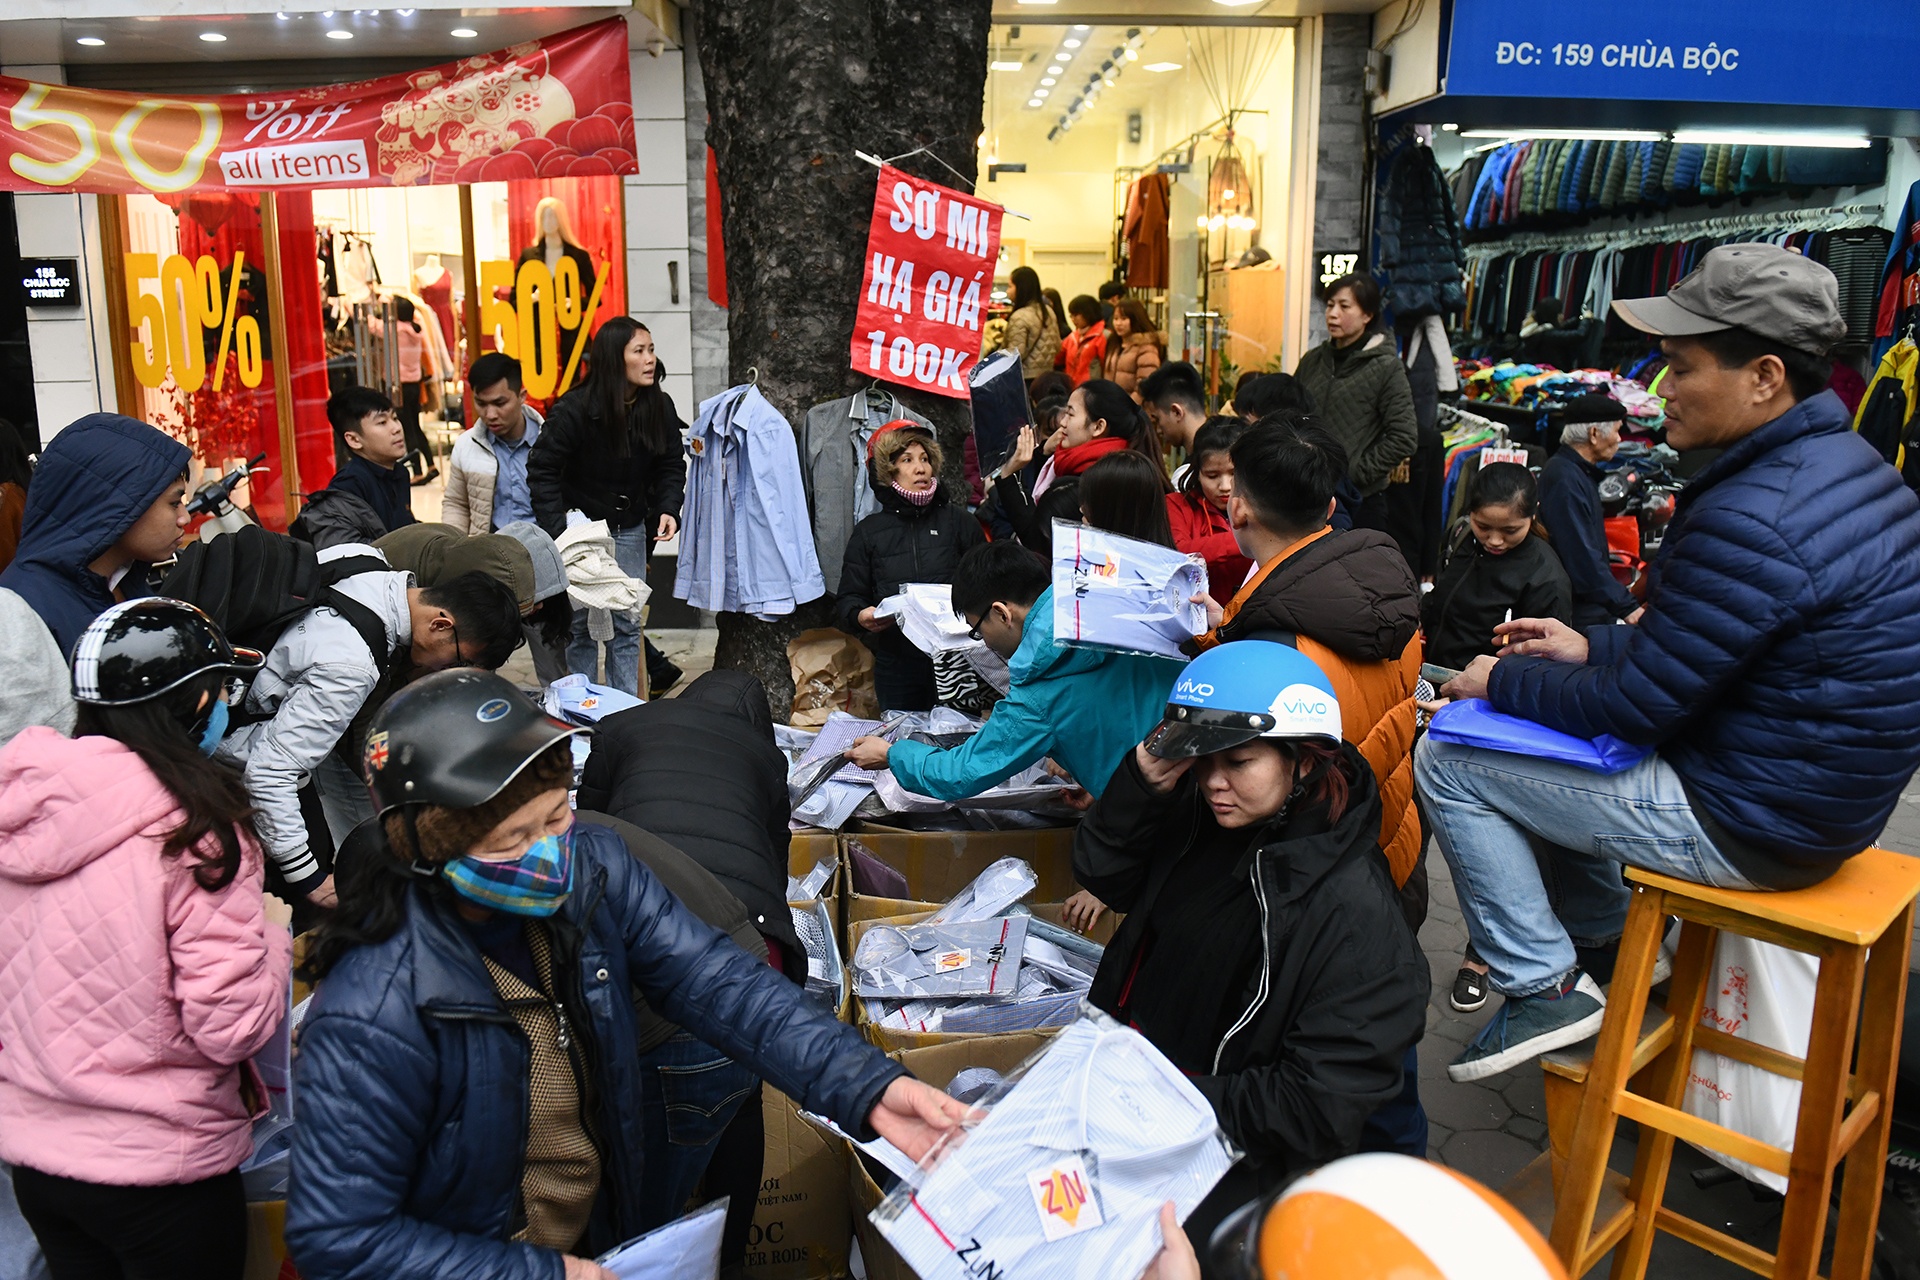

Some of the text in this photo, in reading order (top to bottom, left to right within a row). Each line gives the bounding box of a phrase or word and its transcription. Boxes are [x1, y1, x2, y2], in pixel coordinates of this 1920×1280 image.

[1496, 39, 1739, 76] ĐC: 159 CHÙA BỘC
[9, 82, 223, 193] 50
[226, 151, 361, 180] all items
[890, 181, 990, 259] SƠ MI
[1321, 254, 1359, 275] 157
[23, 278, 49, 288] CHUA
[30, 289, 65, 298] STREET
[867, 252, 985, 332] HẠ GIÁ
[125, 251, 263, 392] 50%
[867, 329, 970, 391] 100K
[1177, 678, 1214, 697] vivo
[1283, 698, 1327, 715] vivo
[782, 1192, 802, 1204] NAM
[1039, 1169, 1087, 1215] ZN
[771, 1246, 809, 1264] RODS
